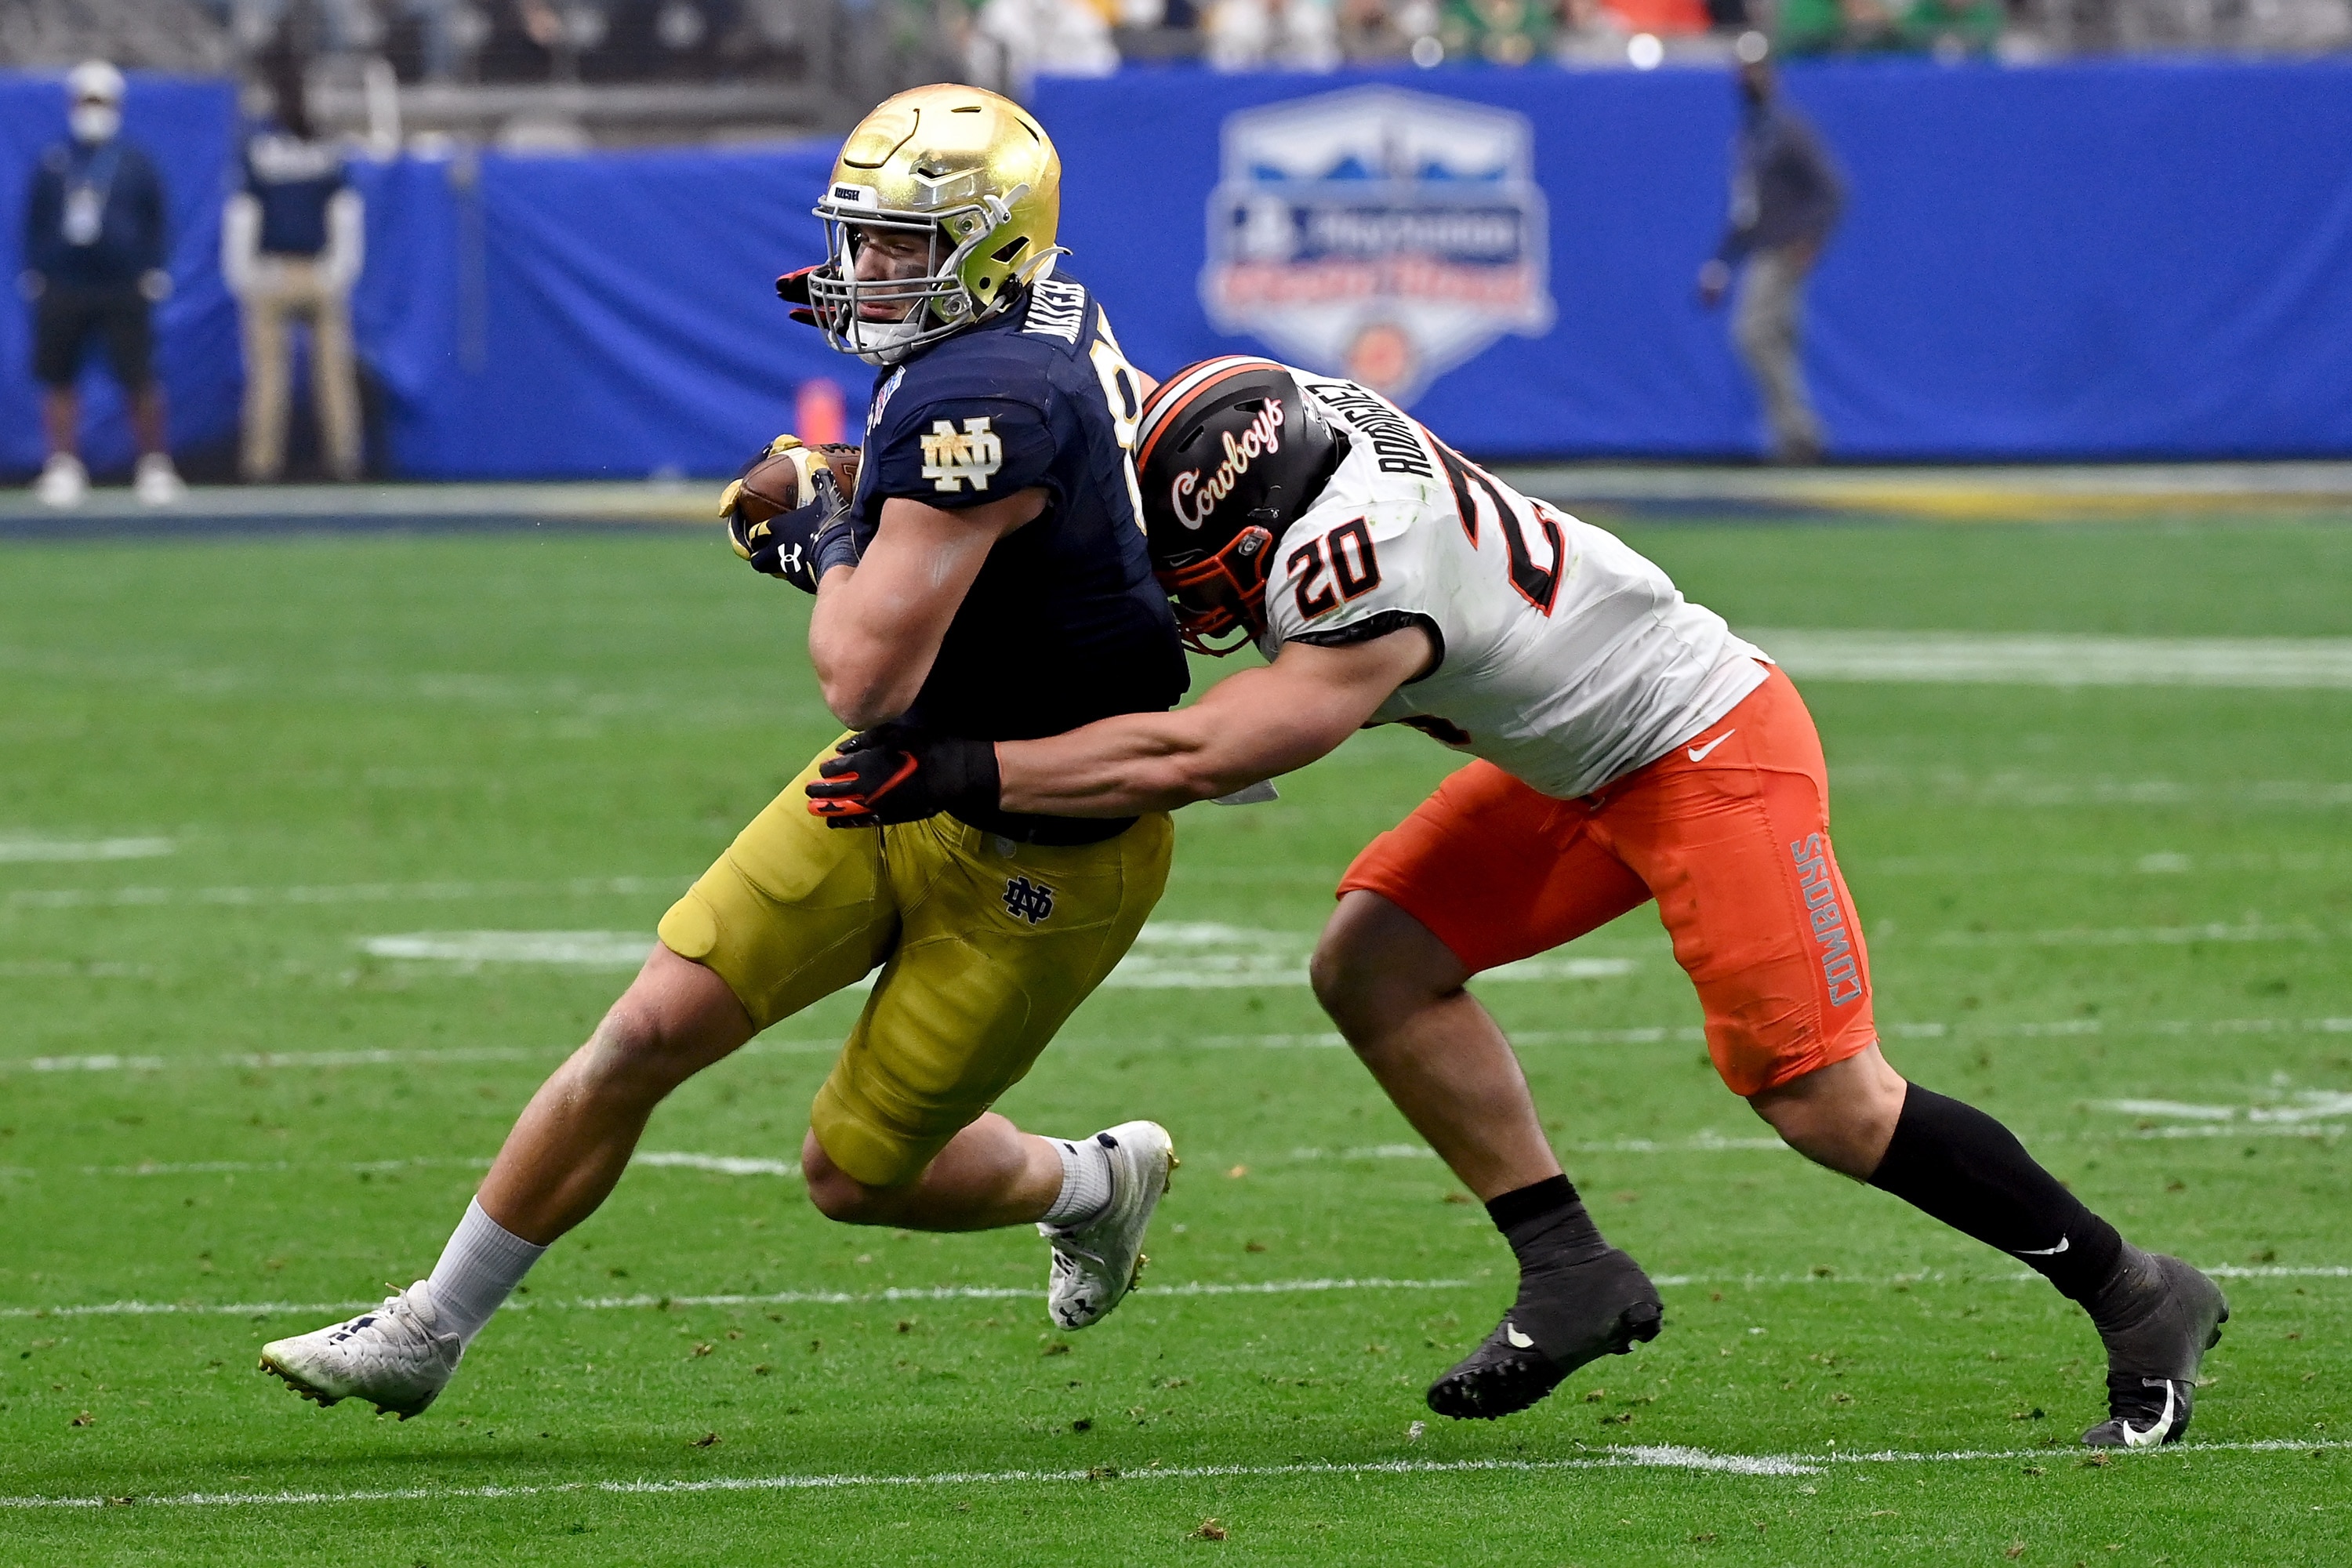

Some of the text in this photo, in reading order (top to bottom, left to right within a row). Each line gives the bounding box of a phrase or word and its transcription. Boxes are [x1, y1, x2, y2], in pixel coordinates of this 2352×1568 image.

[1022, 279, 1085, 345] MAYER
[1171, 396, 1284, 531] Cowboys
[1304, 383, 1434, 479] RODRIGUEZ
[1287, 515, 1382, 621] 20
[1790, 832, 1863, 1007] COWBOYS
